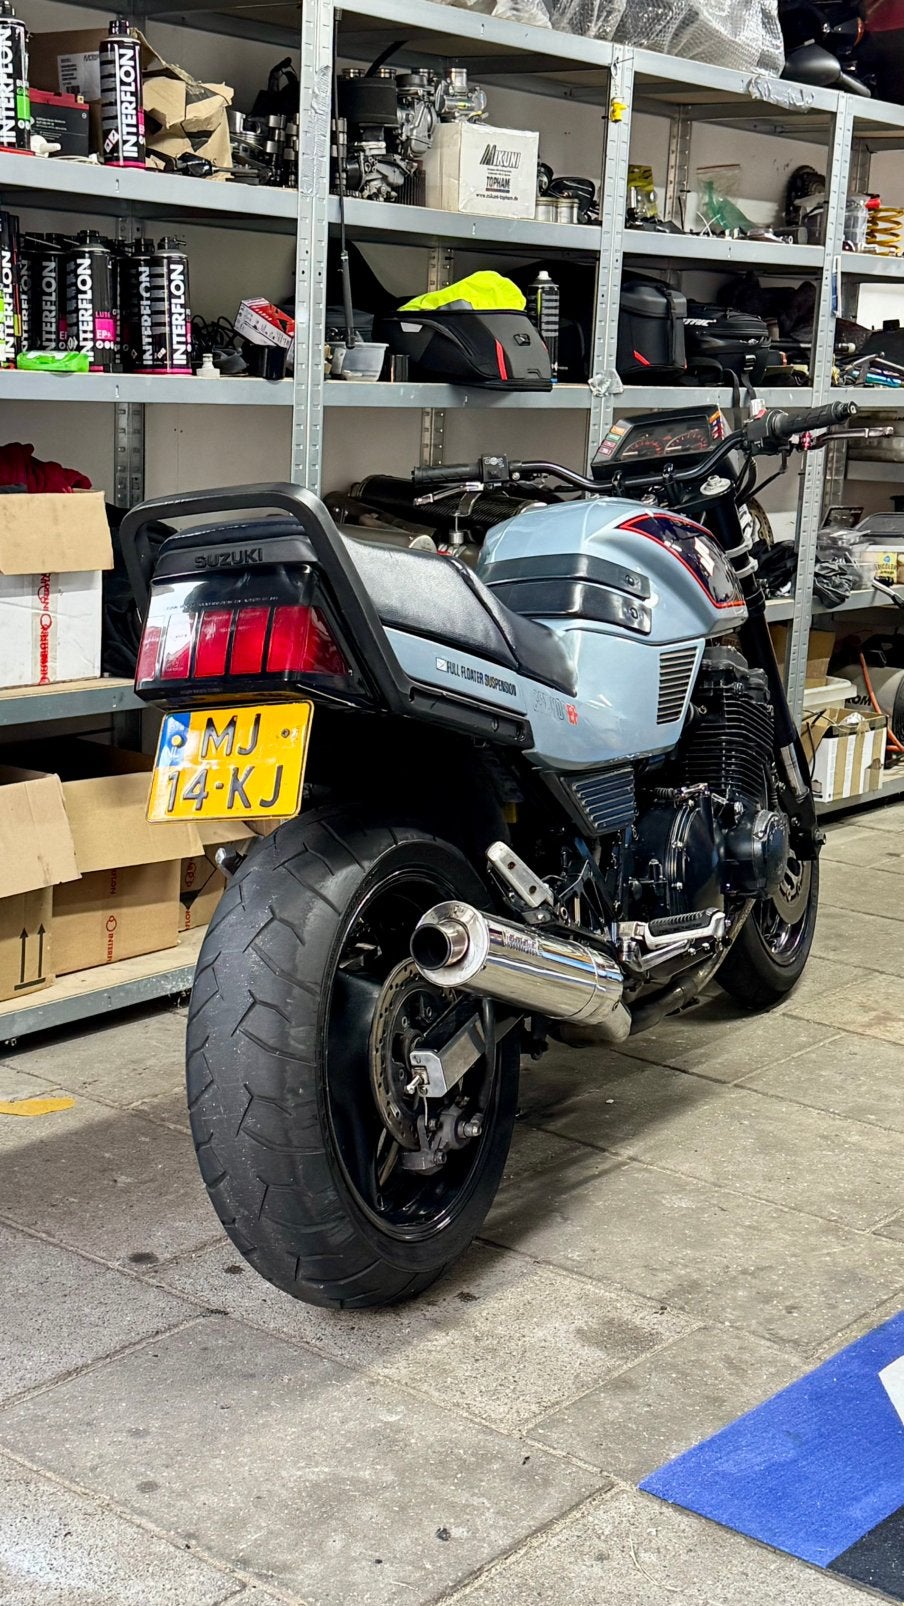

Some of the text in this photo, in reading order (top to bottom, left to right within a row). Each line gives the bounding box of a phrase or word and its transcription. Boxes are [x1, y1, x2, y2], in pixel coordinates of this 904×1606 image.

[0, 25, 16, 143] INTERFLON
[119, 48, 139, 158] INTERFLON
[480, 143, 522, 169] MIKUNI
[486, 176, 511, 189] TOPHAM
[2, 250, 15, 362] INTERFLON
[42, 261, 57, 352] NTERFLON
[170, 264, 187, 365] INTERFLON
[194, 548, 264, 569] SUZUKI
[446, 661, 517, 697] FULL FLOATER SUSPENSION
[201, 713, 262, 759] MJ
[168, 765, 284, 813] 14-KJ
